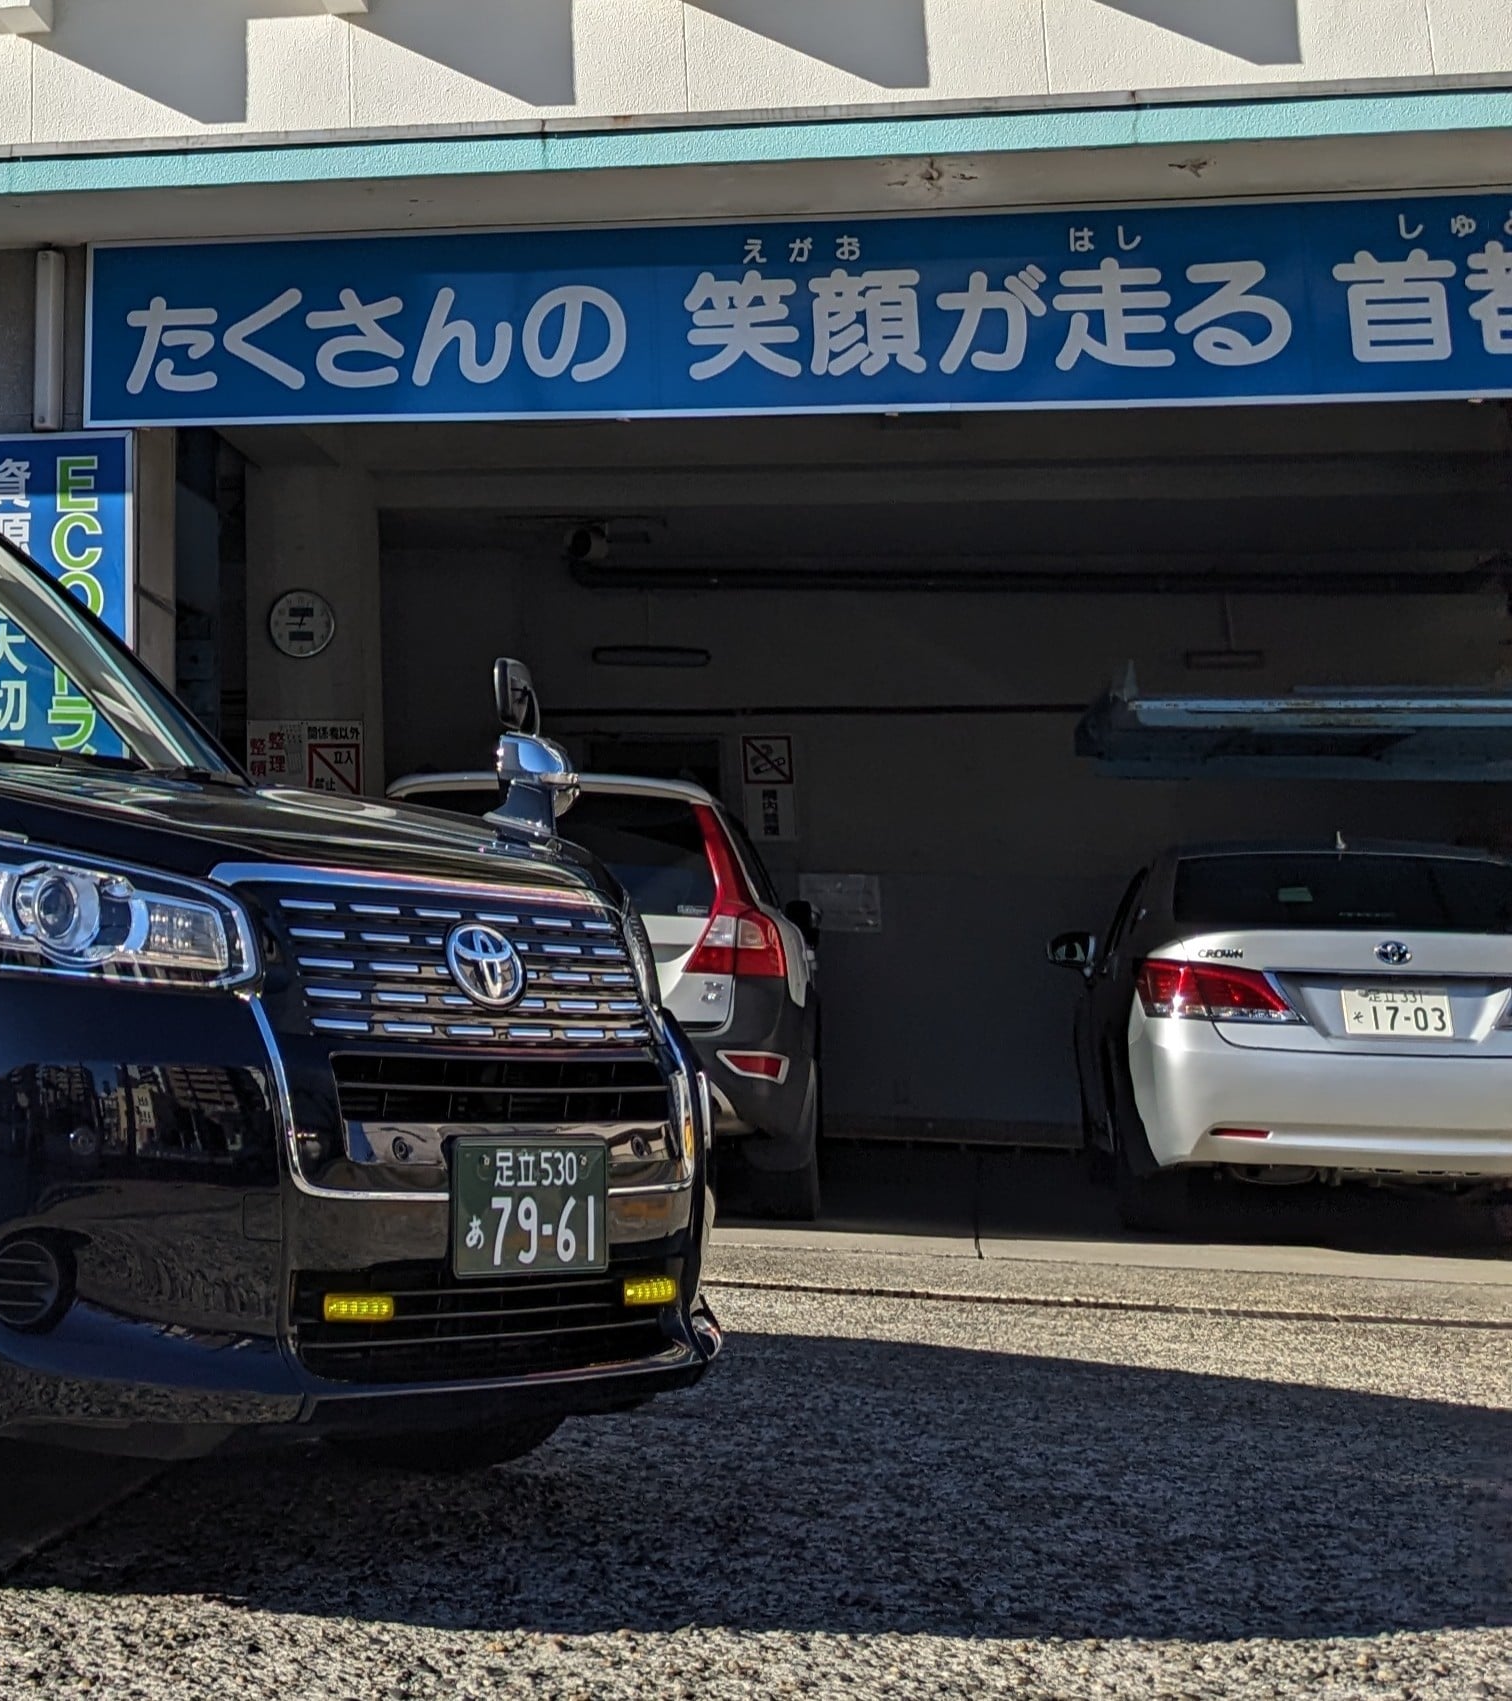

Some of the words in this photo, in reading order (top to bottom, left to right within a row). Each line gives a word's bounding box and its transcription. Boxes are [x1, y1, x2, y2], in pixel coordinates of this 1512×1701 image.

[742, 234, 861, 264] えがお
[1069, 224, 1142, 252] はし
[125, 284, 628, 395] たくさんの
[683, 256, 1292, 381] 笑顔が走る
[307, 726, 360, 740] 関係者以外
[268, 731, 286, 773] 整理
[333, 750, 354, 765] 立入
[1197, 948, 1244, 959] CROWN
[1371, 1005, 1447, 1032] 17-03
[465, 1214, 485, 1250] あ
[491, 1195, 595, 1266] 79-61
